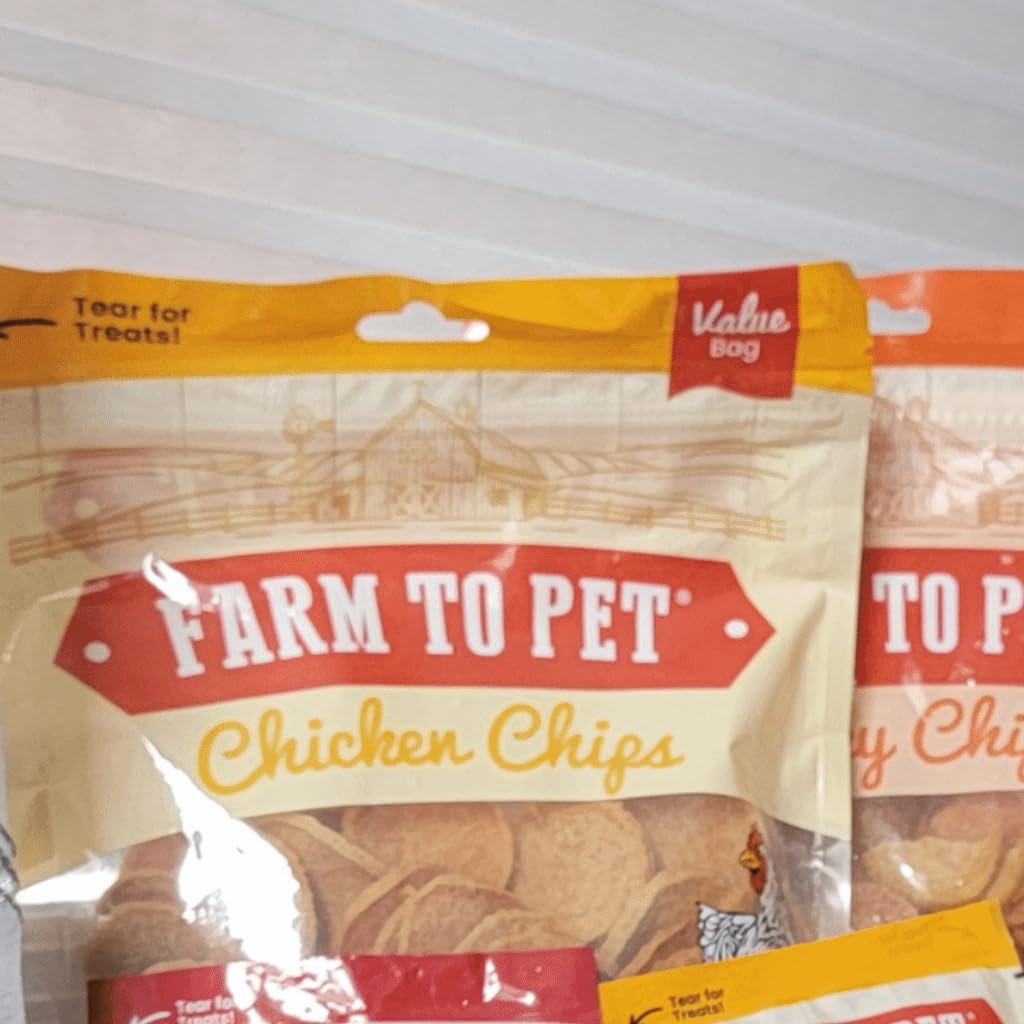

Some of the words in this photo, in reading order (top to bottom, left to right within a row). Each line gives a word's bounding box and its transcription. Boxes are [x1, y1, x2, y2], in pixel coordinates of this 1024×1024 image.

[73, 296, 140, 320] Tear
[150, 302, 191, 323] for
[692, 290, 792, 336] Value
[73, 321, 181, 344] Treats!
[708, 337, 761, 364] Bag
[155, 572, 391, 678] FARM
[405, 571, 505, 657] TO
[872, 571, 960, 654] TO
[196, 697, 475, 796] Chicken
[487, 701, 686, 795] Chips
[175, 998, 213, 1016] Tear
[214, 995, 234, 1011] fo
[668, 993, 701, 1008] Tear
[704, 987, 725, 1001] for
[672, 1001, 725, 1022] Treats!
